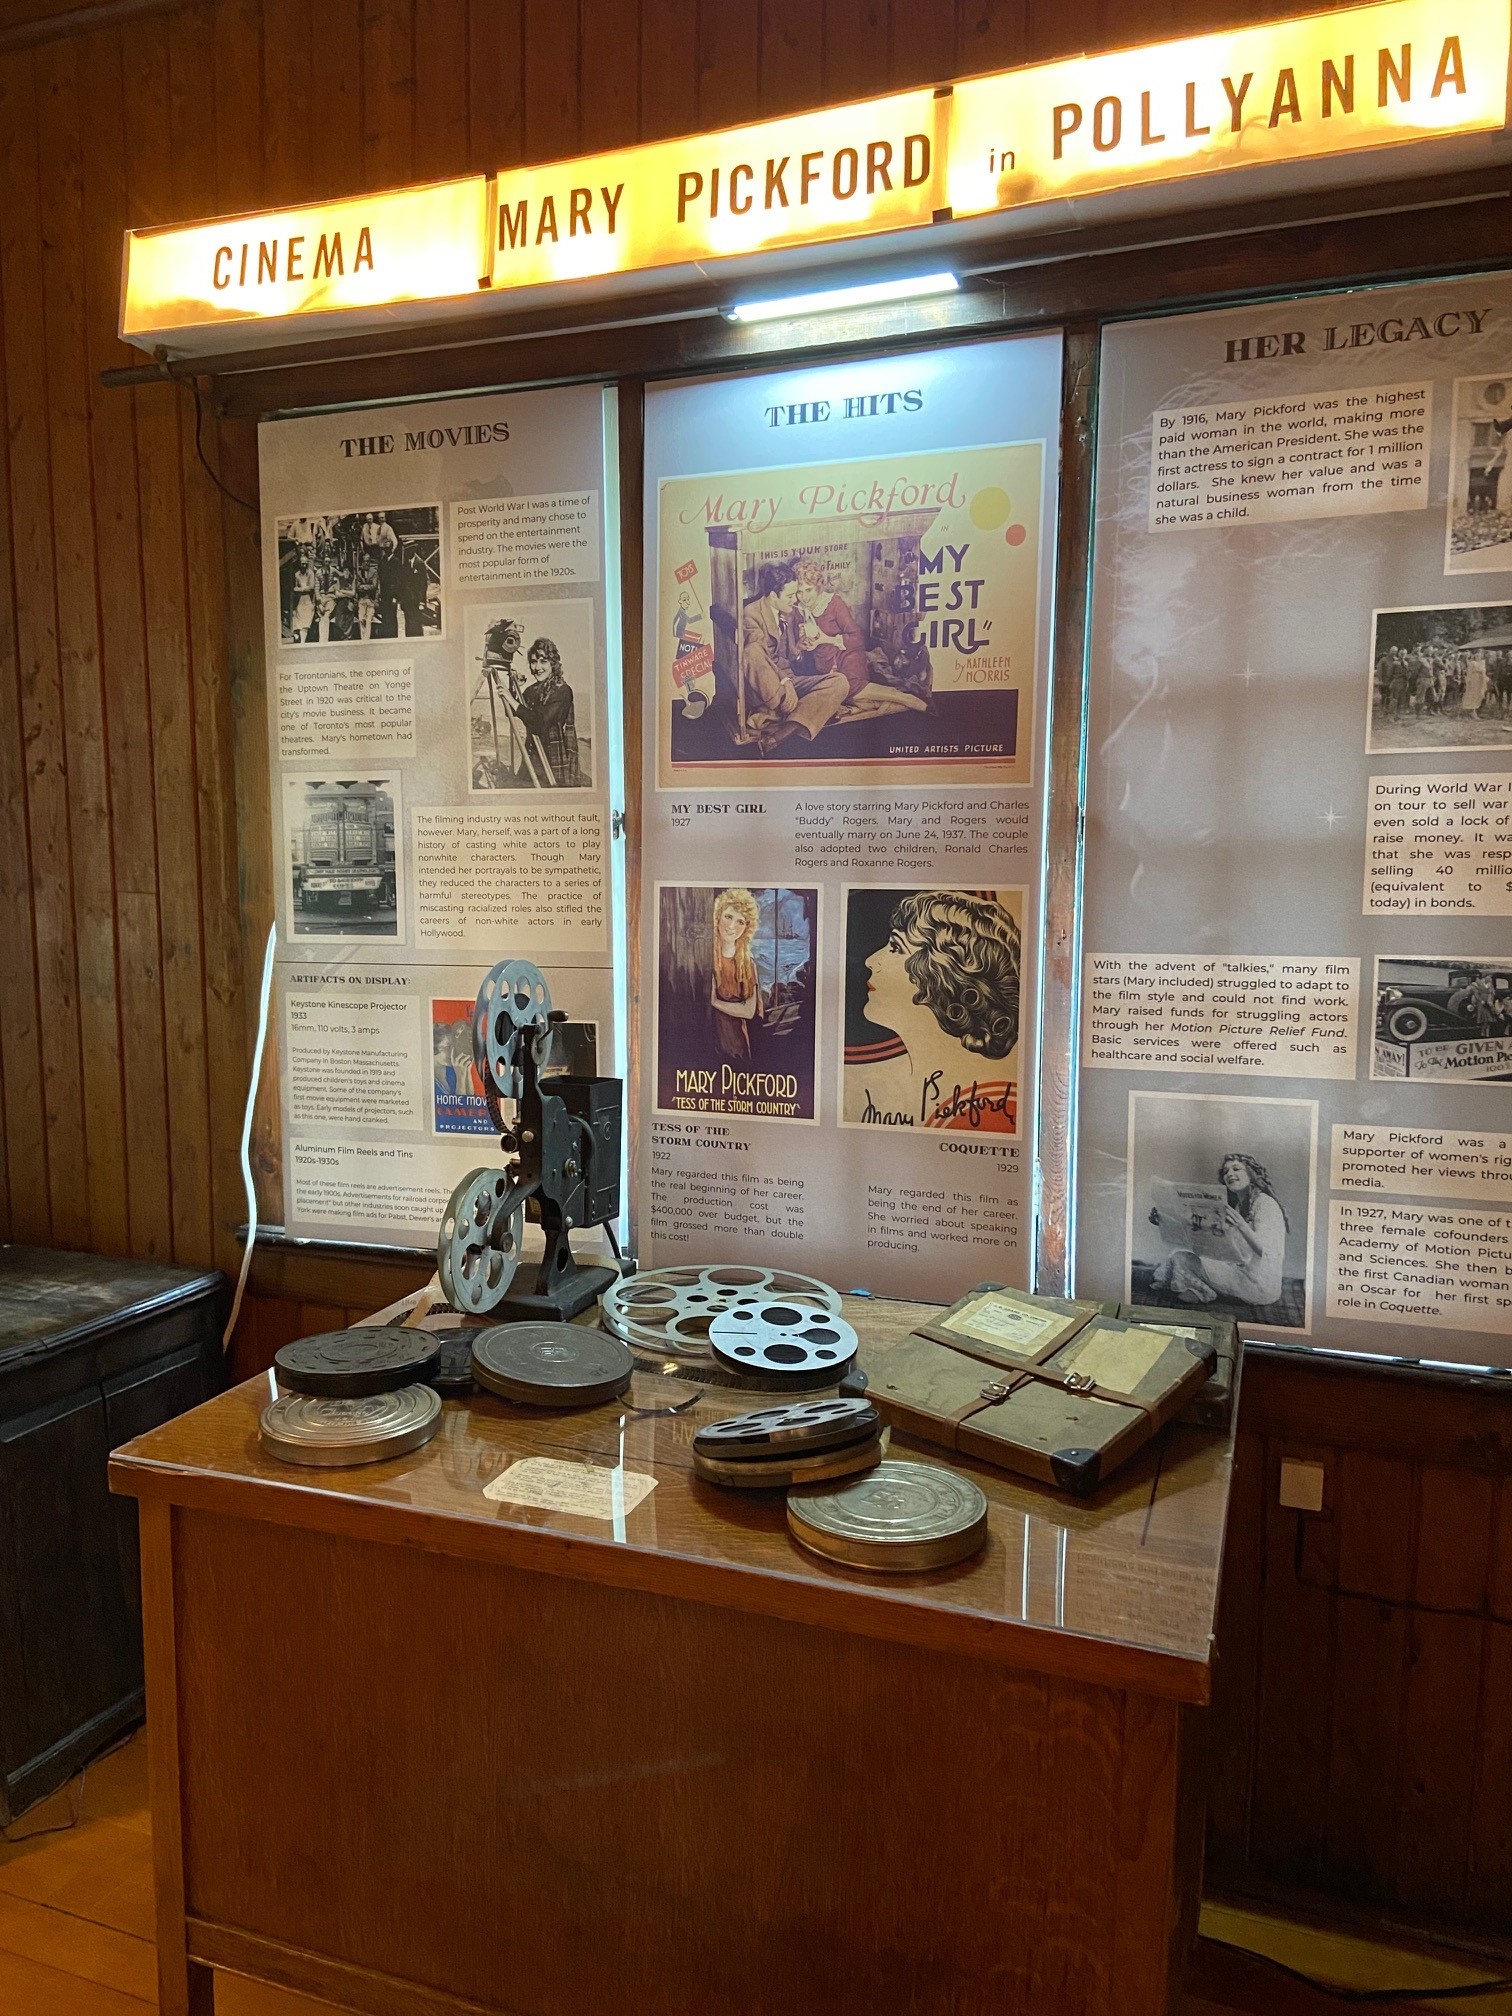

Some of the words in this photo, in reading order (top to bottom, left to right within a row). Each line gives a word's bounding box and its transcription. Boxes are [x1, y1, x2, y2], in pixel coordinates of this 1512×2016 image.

[212, 227, 374, 291] CINEMA
[499, 183, 625, 251] MARY
[678, 133, 930, 224] PICKFORD
[989, 148, 1014, 173] in
[1053, 35, 1466, 160] POLLYANNA
[1223, 331, 1306, 363] HER
[1322, 309, 1492, 351] LEGACY
[764, 401, 831, 427] THE
[843, 388, 923, 419] HITS
[1160, 417, 1176, 430] By
[1181, 413, 1209, 428] 1916,
[1215, 410, 1247, 422] Mary
[1253, 401, 1306, 417] Pickford
[1313, 400, 1339, 410] was
[1346, 396, 1368, 407] the
[1375, 390, 1426, 405] highest
[339, 434, 395, 458] THE
[404, 422, 510, 451] MOVIES
[457, 506, 476, 515] Post
[478, 504, 504, 514] World
[507, 502, 525, 511] War
[527, 501, 530, 509] I
[532, 501, 549, 509] was
[551, 500, 556, 508] a
[558, 498, 579, 507] time
[581, 496, 591, 505] of
[679, 494, 782, 533] Mary
[799, 473, 966, 528] Pickford
[761, 551, 778, 560] THIS
[824, 543, 848, 553] STORE
[826, 561, 850, 570] FAMILY
[919, 544, 970, 575] MY
[677, 563, 694, 580] TOYS
[891, 580, 985, 614] BEST
[674, 649, 708, 672] TINWARE
[280, 673, 292, 681] For
[295, 671, 347, 680] Torontonians,
[350, 670, 363, 678] the
[366, 668, 399, 678] opening
[402, 667, 411, 675] of
[953, 659, 966, 683] by
[966, 657, 1011, 669] KATHLEEN
[966, 669, 1010, 683] NORRIS
[889, 746, 919, 754] UNITED
[924, 745, 959, 753] ARTISTS
[964, 744, 1003, 752] PICTURE
[1375, 784, 1421, 796] During
[1426, 782, 1468, 794] World
[1473, 783, 1503, 793] War
[671, 804, 692, 814] MY
[696, 804, 731, 814] BEST
[734, 803, 767, 814] GIRL
[795, 803, 803, 811] A
[805, 803, 824, 811] love
[827, 804, 851, 812] story
[853, 802, 891, 812] starring
[894, 802, 919, 812] Mary
[922, 801, 964, 810] Pickford
[967, 801, 987, 809] and
[990, 801, 1029, 809] Charles
[417, 815, 432, 823] The
[435, 815, 464, 825] filming
[467, 815, 501, 825] industry
[541, 814, 575, 822] without
[578, 814, 600, 822] fault,
[672, 817, 690, 827] 1927
[843, 817, 879, 826] Rogers.
[888, 817, 913, 826] Mary
[921, 816, 941, 824] and
[951, 816, 986, 826] Rogers
[996, 815, 1029, 824] would
[1093, 960, 1122, 970] With
[1128, 960, 1148, 971] the
[1154, 961, 1196, 972] advent
[1202, 962, 1216, 972] of
[1222, 962, 1275, 974] "talkies,"
[1282, 965, 1318, 976] many
[1325, 961, 1350, 975] film
[290, 975, 346, 984] ARTIFACTS
[348, 976, 362, 984] ON
[365, 976, 411, 985] DISPLAY:
[291, 1000, 326, 1009] Keystone
[328, 1001, 368, 1010] Kinescope
[371, 1002, 407, 1011] Projector
[291, 1024, 316, 1032] 16mm,
[330, 1025, 350, 1034] volts,
[357, 1027, 380, 1036] amps
[1419, 1048, 1432, 1057] TO
[1455, 1041, 1503, 1055] GIVEN
[1443, 1056, 1494, 1069] Motion
[676, 1069, 717, 1093] MARY
[722, 1064, 798, 1098] PICKFORD
[466, 1096, 487, 1106] MOV
[699, 1098, 709, 1110] OF
[710, 1099, 725, 1112] THE
[728, 1100, 754, 1113] STORM
[921, 1070, 1016, 1127] Pickford
[439, 1124, 495, 1132] PROJECTORS
[651, 1122, 682, 1133] TESS
[685, 1124, 701, 1134] OF
[704, 1126, 730, 1136] THE
[651, 1135, 691, 1147] STORM
[695, 1139, 751, 1151] COUNTRY
[1343, 1130, 1375, 1143] Mary
[1389, 1132, 1443, 1145] Pickford
[1457, 1139, 1484, 1148] was
[1498, 1141, 1506, 1149] a
[294, 1144, 335, 1154] Aluminum
[338, 1147, 355, 1155] Film
[357, 1148, 378, 1156] Reels
[379, 1149, 395, 1157] and
[396, 1150, 413, 1158] Tins
[652, 1151, 671, 1160] 1922
[938, 1142, 1020, 1158] COQUETTE
[294, 1155, 340, 1166] 1920s-1930s
[996, 1162, 1020, 1174] 1929
[651, 1167, 673, 1178] Mary
[676, 1170, 717, 1180] regarded
[721, 1173, 738, 1182] this
[742, 1174, 760, 1183] film
[777, 1177, 804, 1188] being
[1340, 1206, 1354, 1217] In
[1356, 1207, 1387, 1220] 1927,
[1391, 1210, 1424, 1224] Mary
[1427, 1214, 1454, 1224] was
[1458, 1217, 1484, 1226] one
[1487, 1217, 1502, 1227] of
